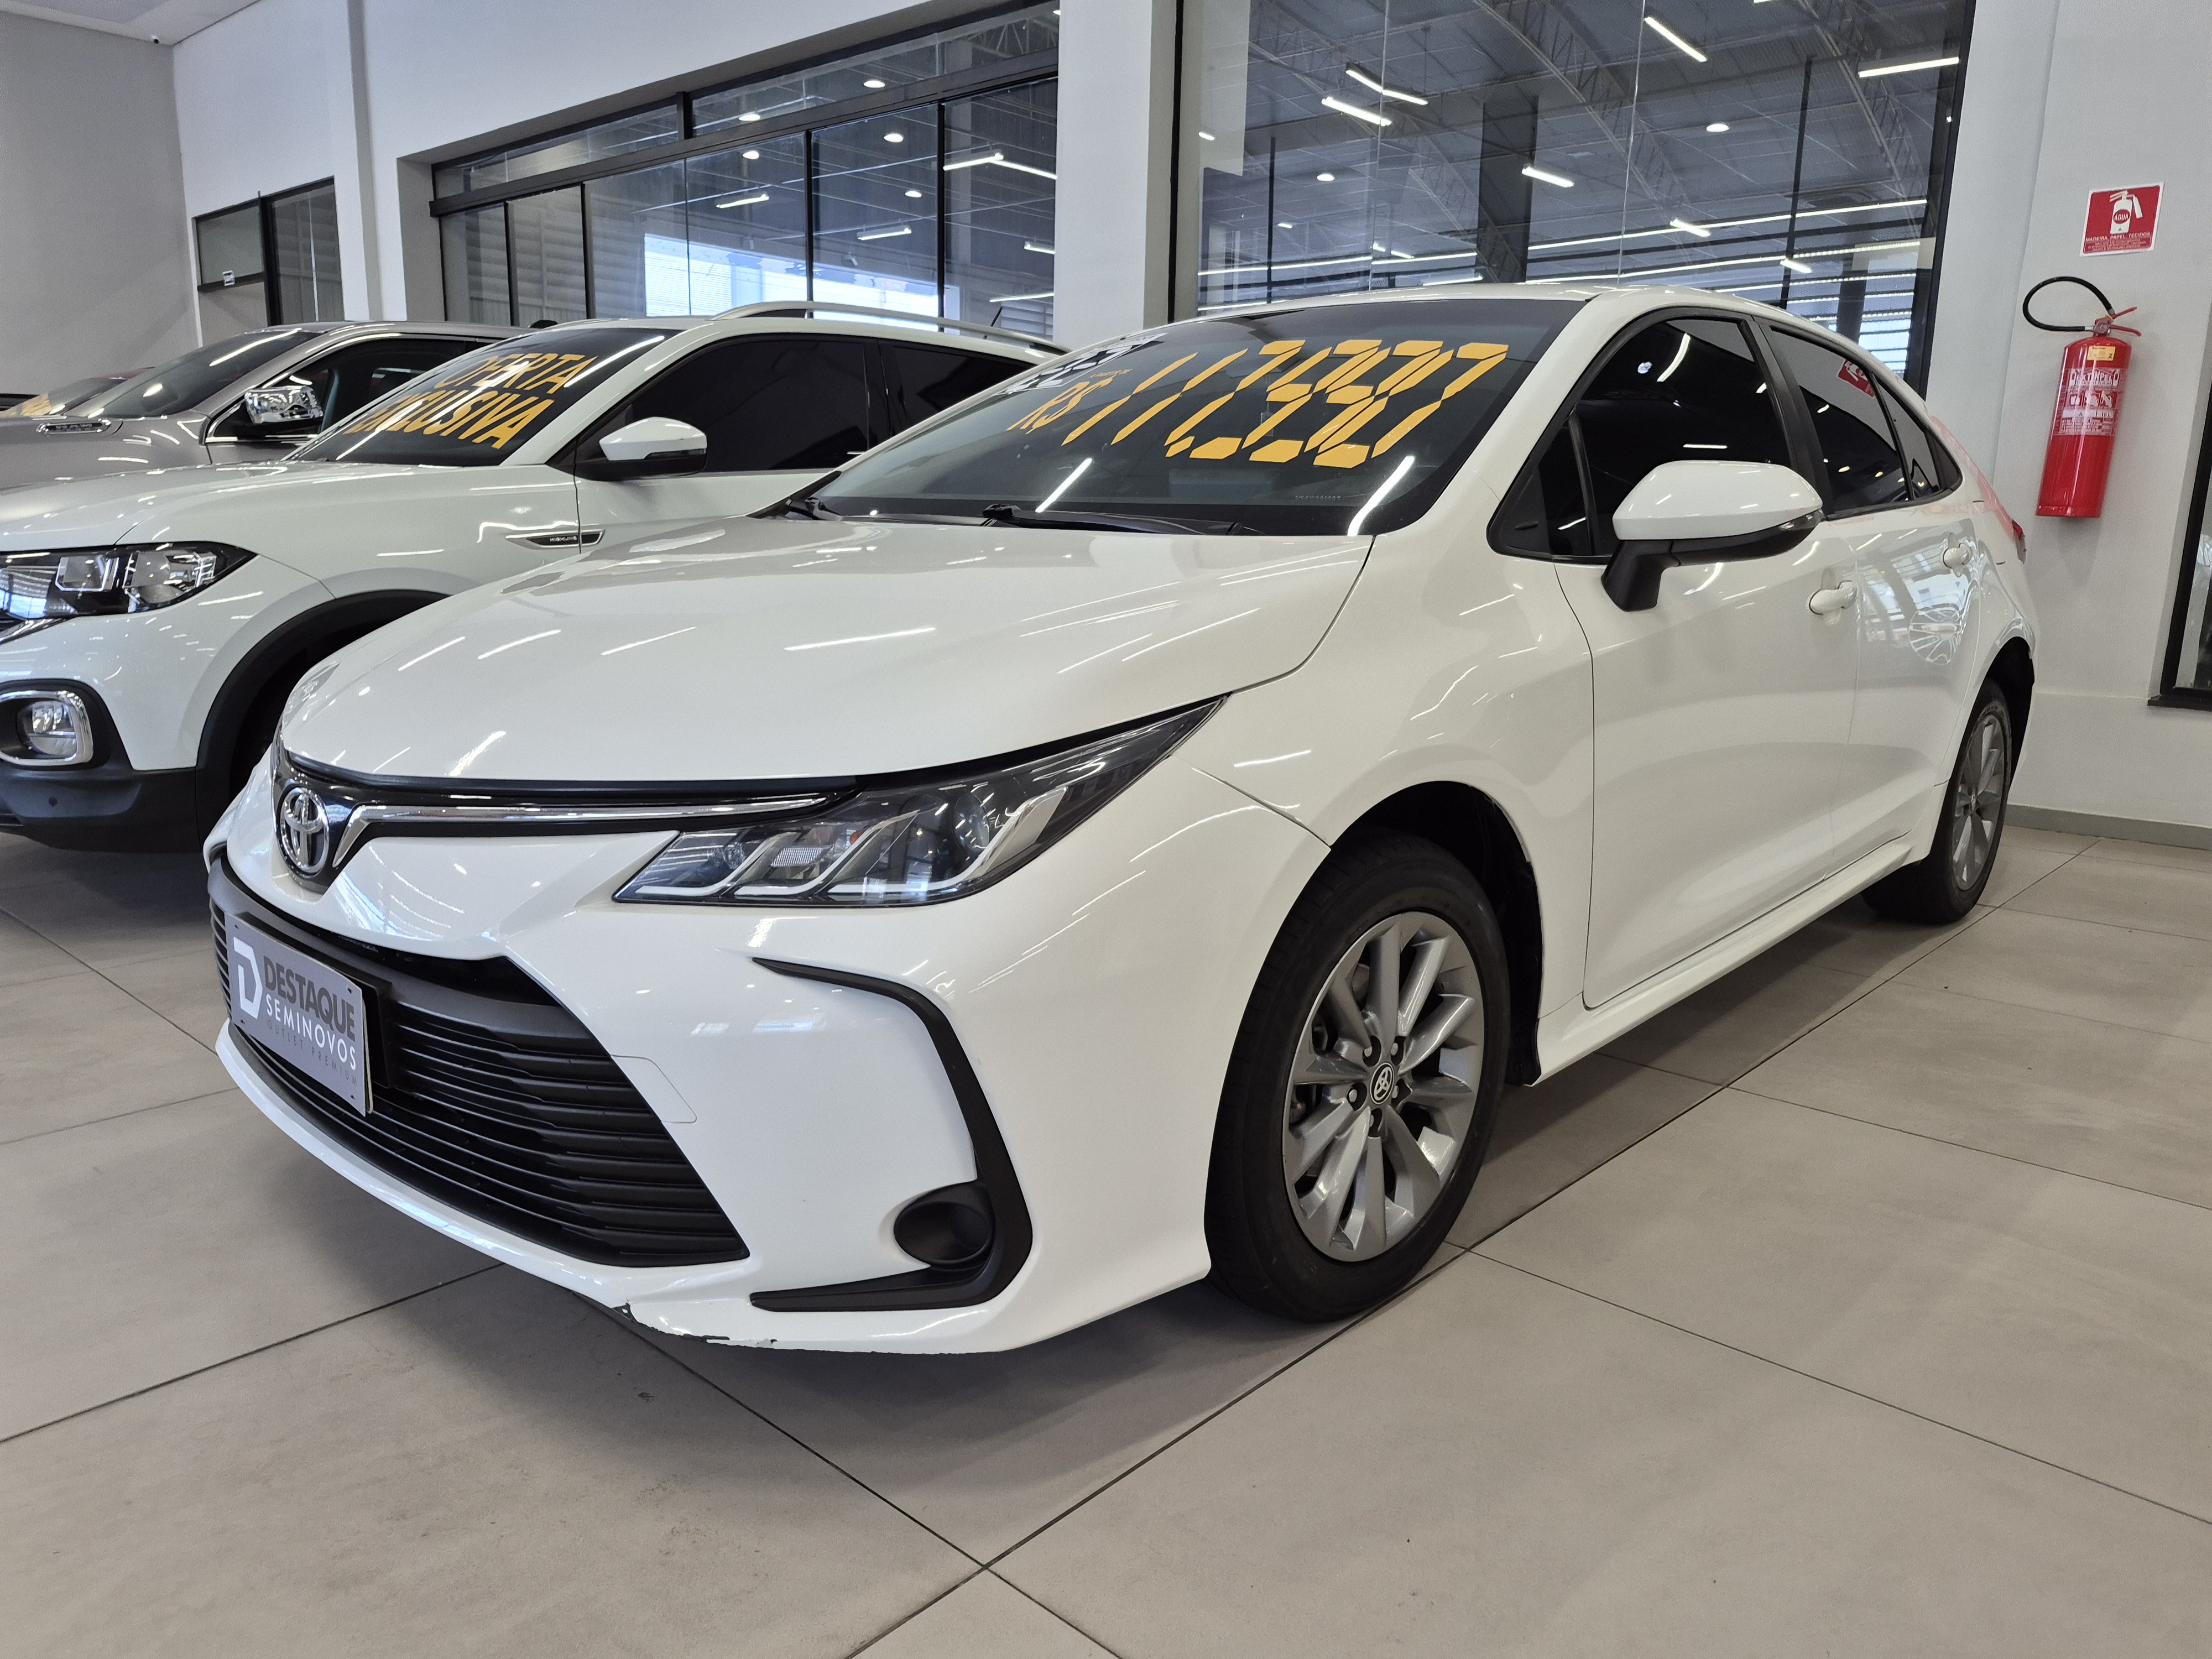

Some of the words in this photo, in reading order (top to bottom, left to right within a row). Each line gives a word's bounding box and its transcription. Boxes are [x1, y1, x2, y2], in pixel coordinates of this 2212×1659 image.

[434, 353, 598, 394] OFERTA
[1005, 373, 1118, 435] R$
[343, 390, 555, 450] EXCLUSIVA
[263, 955, 356, 1042] DESTAQUE
[266, 994, 356, 1071] SEMINOVOS
[267, 1019, 303, 1049] OUTLET
[311, 1047, 357, 1087] PREMIUM
